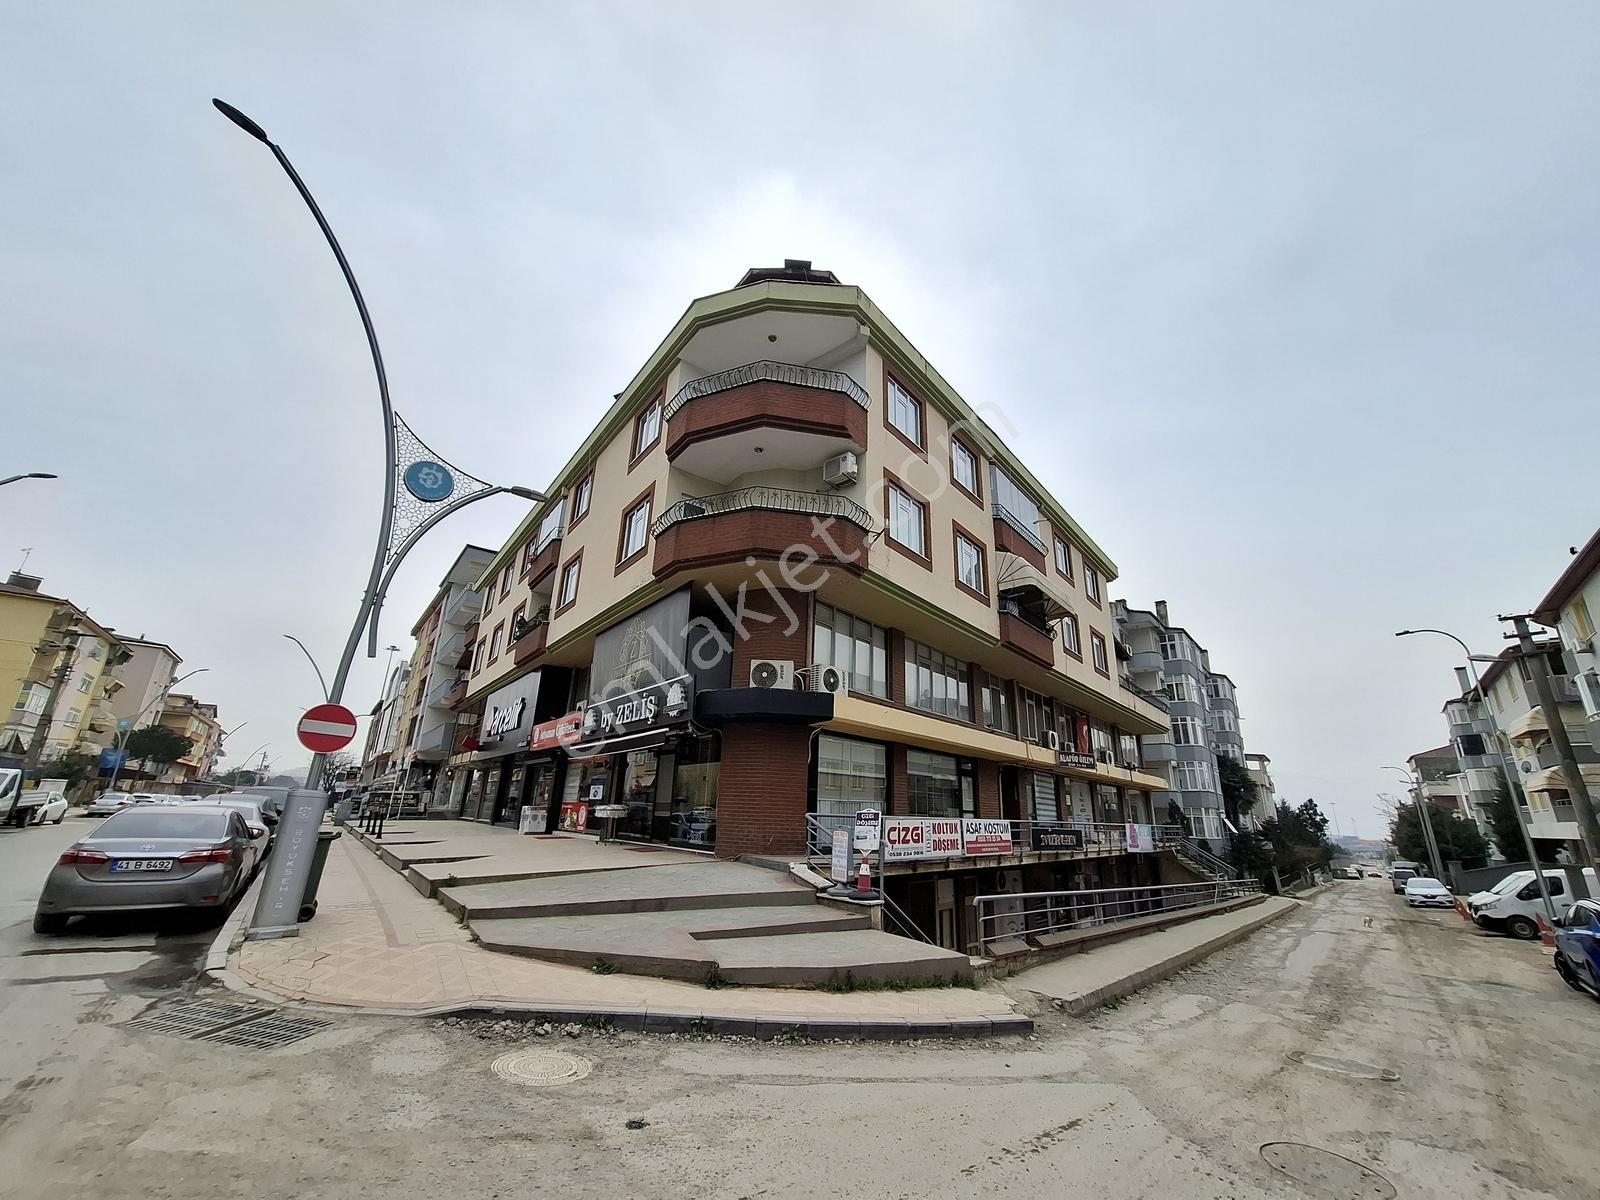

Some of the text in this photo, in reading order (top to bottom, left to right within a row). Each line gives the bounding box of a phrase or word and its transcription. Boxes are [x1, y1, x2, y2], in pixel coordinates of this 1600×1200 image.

[601, 692, 657, 732] by ZELİŞ
[887, 821, 924, 850] ÇİZGİ
[932, 822, 959, 834] KOLTUK
[932, 837, 960, 853] DÖŞEME
[118, 861, 171, 869] 41 B 6492
